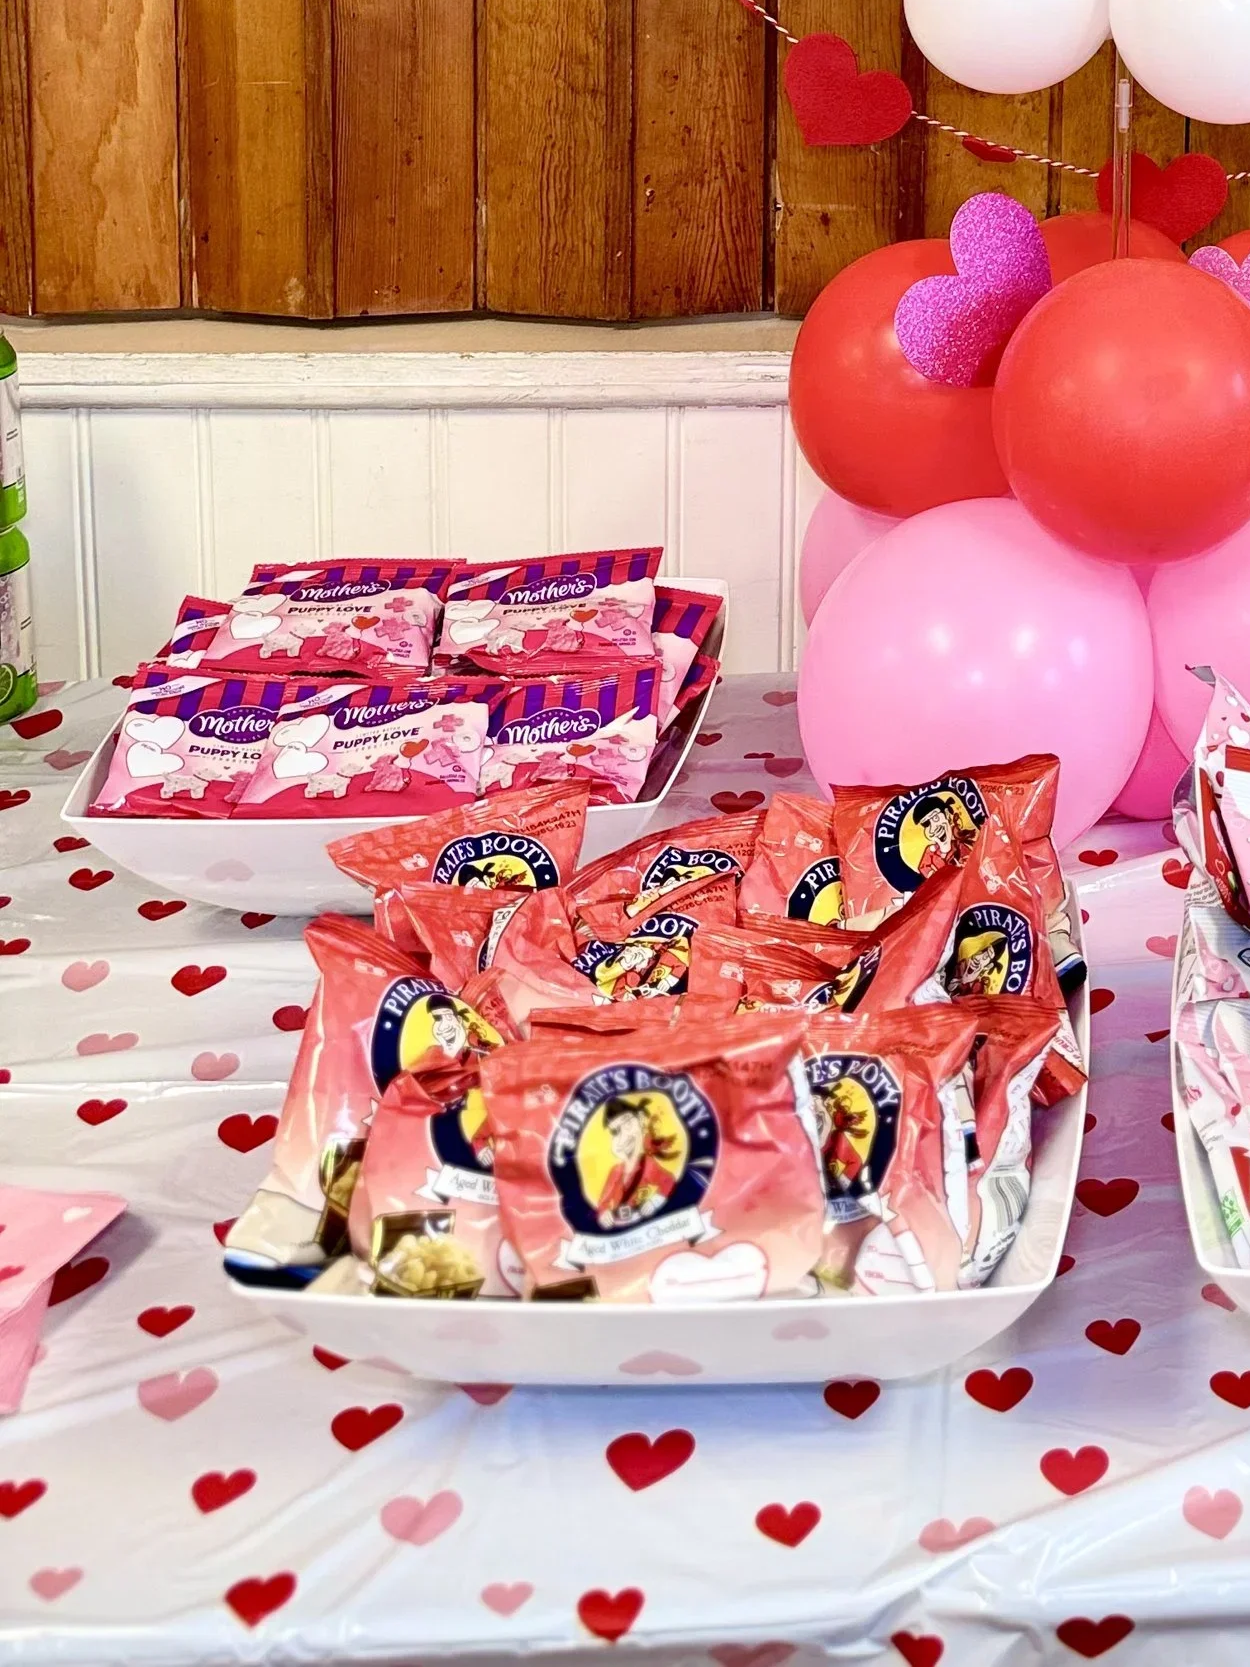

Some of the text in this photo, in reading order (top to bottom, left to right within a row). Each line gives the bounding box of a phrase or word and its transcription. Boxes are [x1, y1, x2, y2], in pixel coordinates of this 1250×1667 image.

[300, 581, 385, 601] Mother's
[508, 578, 594, 604] Mother's
[288, 605, 372, 615] PUPPY LOVE
[199, 714, 273, 736] Mother
[505, 715, 596, 745] Mother's
[333, 735, 380, 751] PUPPY
[382, 727, 421, 742] LOVE
[188, 745, 240, 761] PUPPY
[242, 748, 262, 761] LO
[481, 835, 550, 868] BOOTY
[687, 852, 732, 873] BOO
[384, 978, 445, 1017] PIRATE
[554, 1069, 711, 1167] PIRATE'S BOOTY
